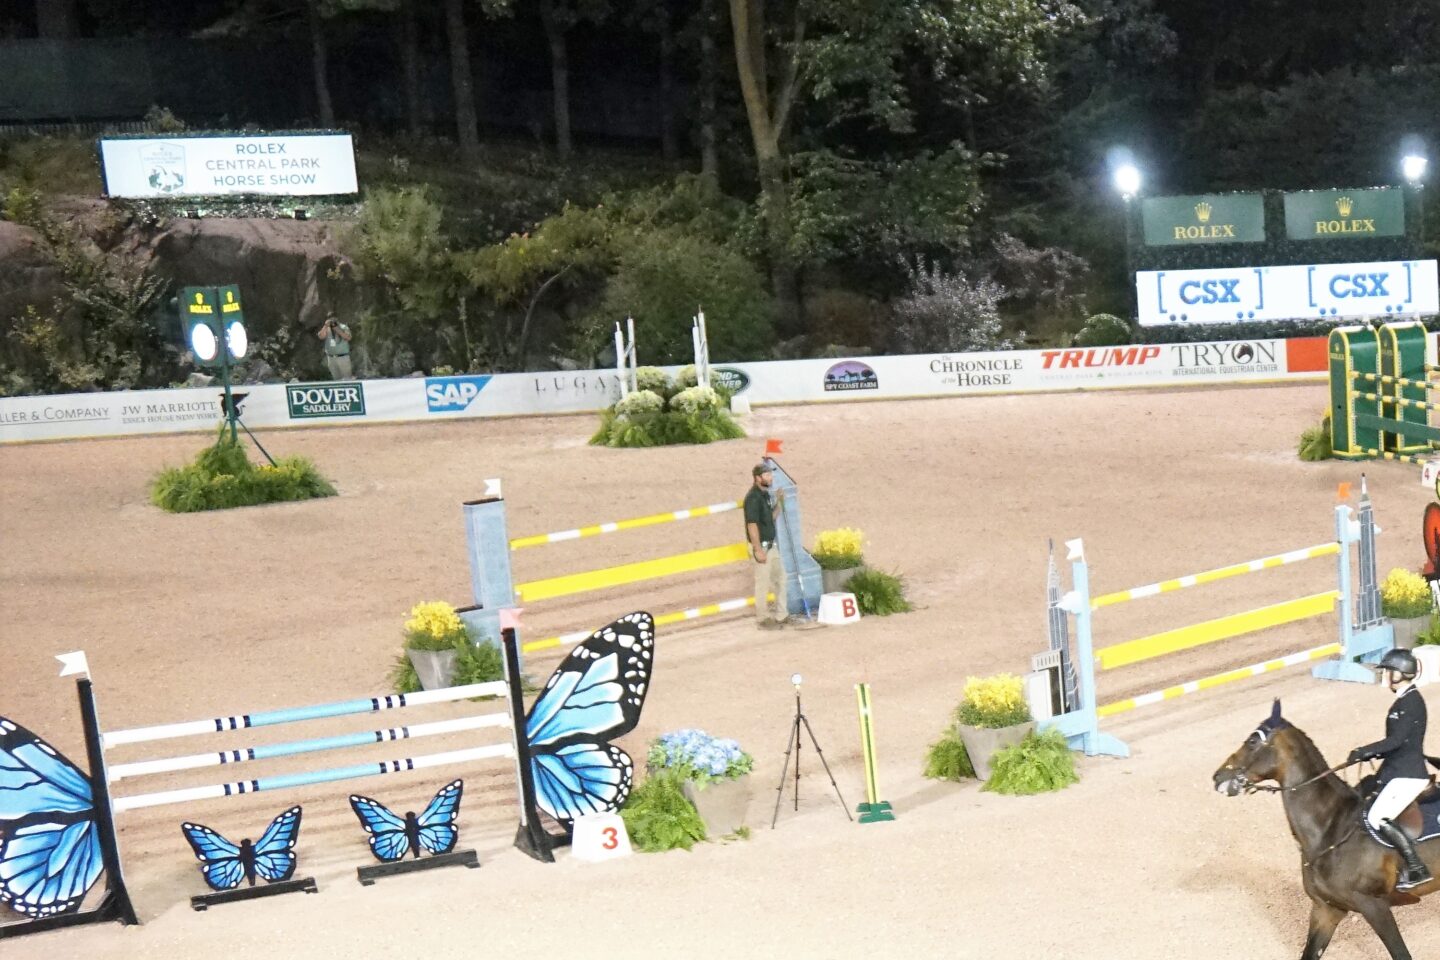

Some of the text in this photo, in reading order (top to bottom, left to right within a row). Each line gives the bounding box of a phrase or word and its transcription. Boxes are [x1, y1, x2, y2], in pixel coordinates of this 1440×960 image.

[236, 143, 287, 155] ROLEX
[205, 157, 321, 171] CENTRAL PARK
[213, 173, 316, 186] HORSE SHOW
[1174, 224, 1235, 240] ROLEX
[1316, 219, 1376, 234] ROLEX
[1179, 279, 1241, 305] CSX
[1329, 273, 1390, 299] CSX
[1040, 346, 1162, 370] TRUMP
[1171, 341, 1276, 367] TRYON
[929, 359, 1024, 373] CHRONICLE
[1172, 364, 1278, 376] INTERNATIONAL EQUESTRIAN CENTER
[860, 381, 877, 389] FARM
[957, 373, 1012, 387] HORSE
[291, 386, 359, 405] DOVER
[427, 383, 478, 406] SAP
[31, 411, 40, 421] &
[43, 406, 110, 420] COMPANY
[121, 401, 217, 415] JW MARRIOTT
[302, 403, 351, 414] SADDLERY
[1424, 467, 1430, 481] 4
[841, 598, 856, 618] B
[602, 826, 619, 850] 3
